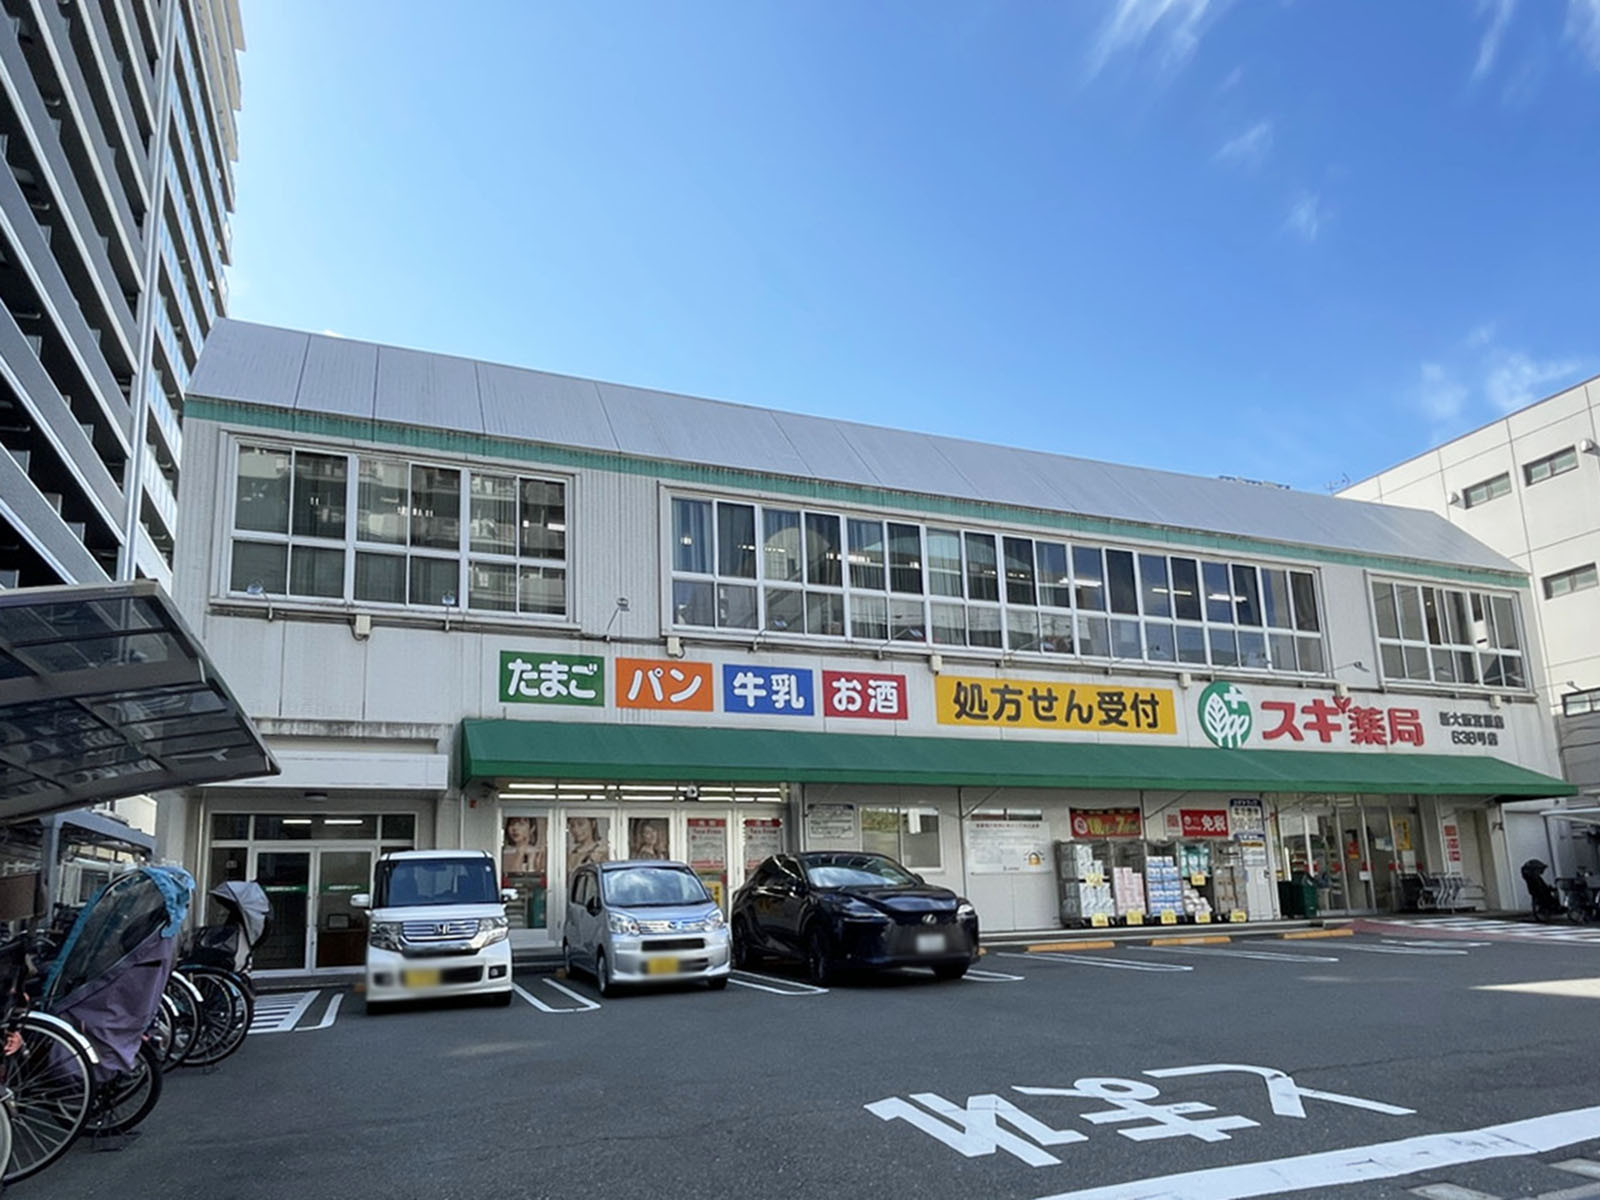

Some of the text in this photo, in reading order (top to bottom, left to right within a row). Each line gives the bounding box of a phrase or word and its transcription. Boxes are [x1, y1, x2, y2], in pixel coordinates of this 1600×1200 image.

[507, 657, 598, 701] たまご
[626, 667, 703, 704] パン
[732, 671, 806, 710] 牛乳
[831, 677, 899, 714] お酒
[953, 680, 1161, 730] 処方せん受付
[1260, 695, 1425, 747] スギ薬局
[862, 1062, 1417, 1167] とまれ
